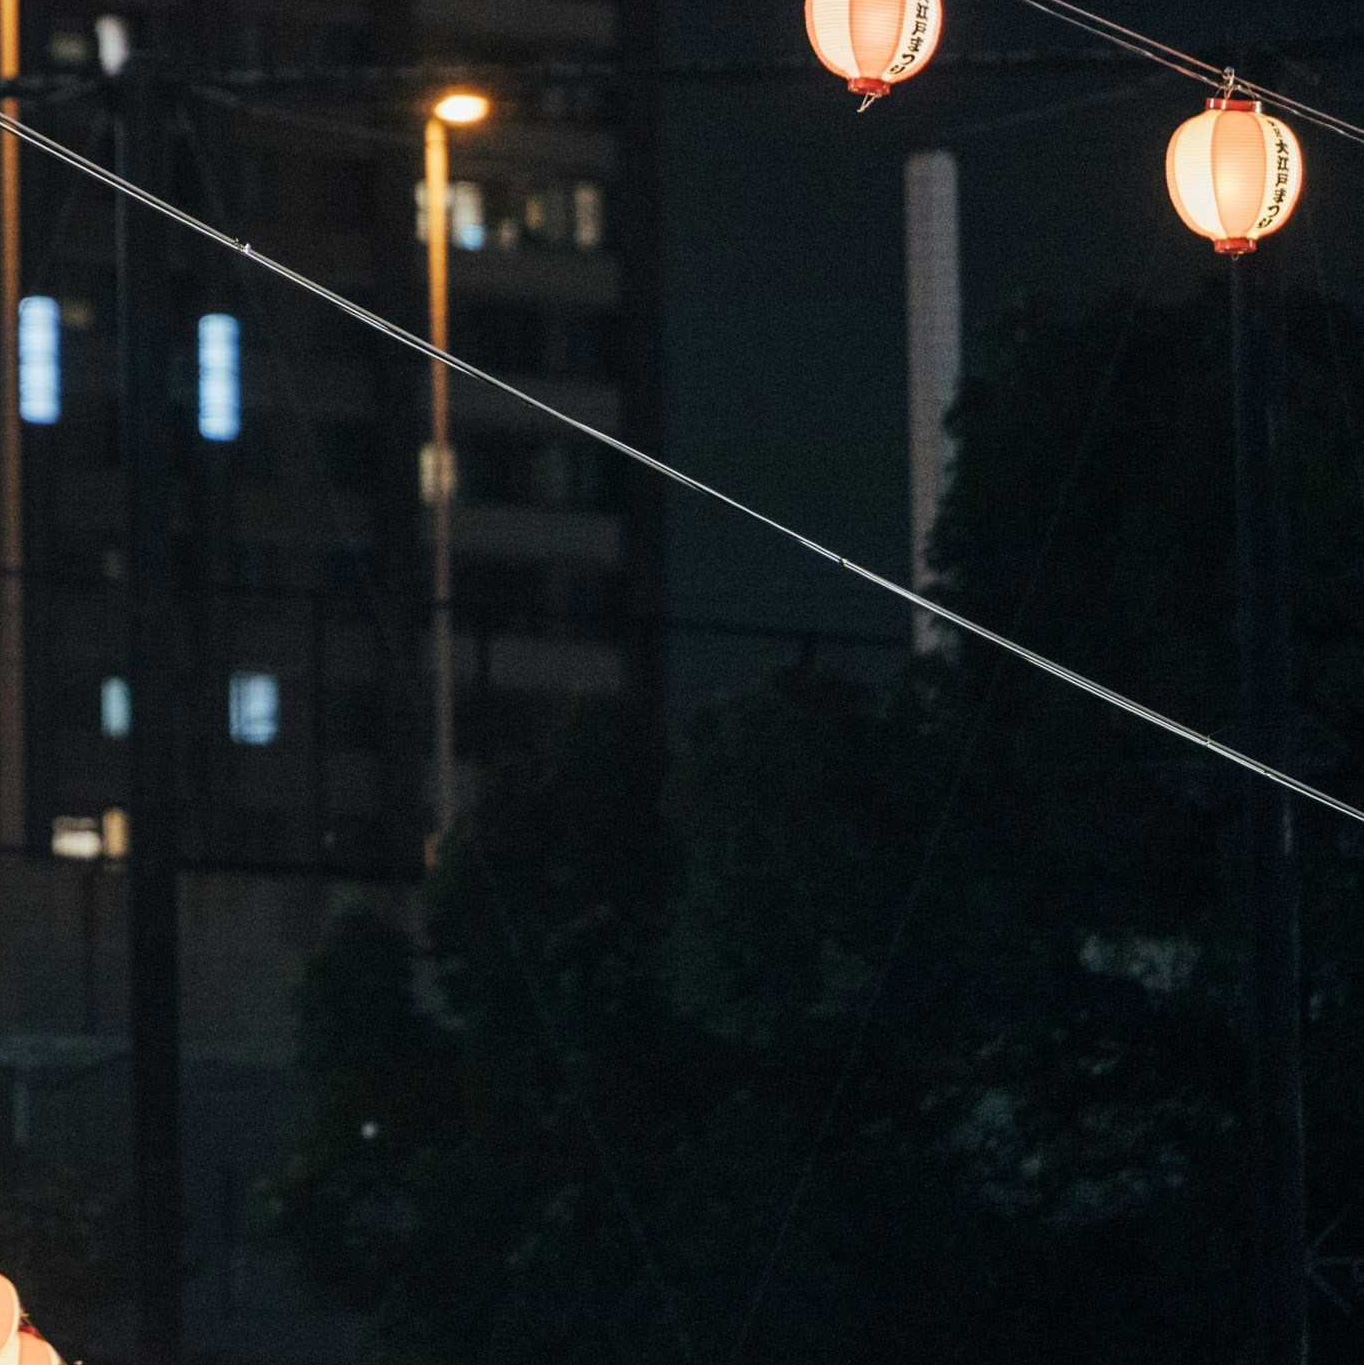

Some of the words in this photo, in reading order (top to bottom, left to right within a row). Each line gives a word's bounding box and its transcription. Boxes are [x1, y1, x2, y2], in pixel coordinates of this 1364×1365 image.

[1256, 139, 1290, 229] 大江戸まつり
